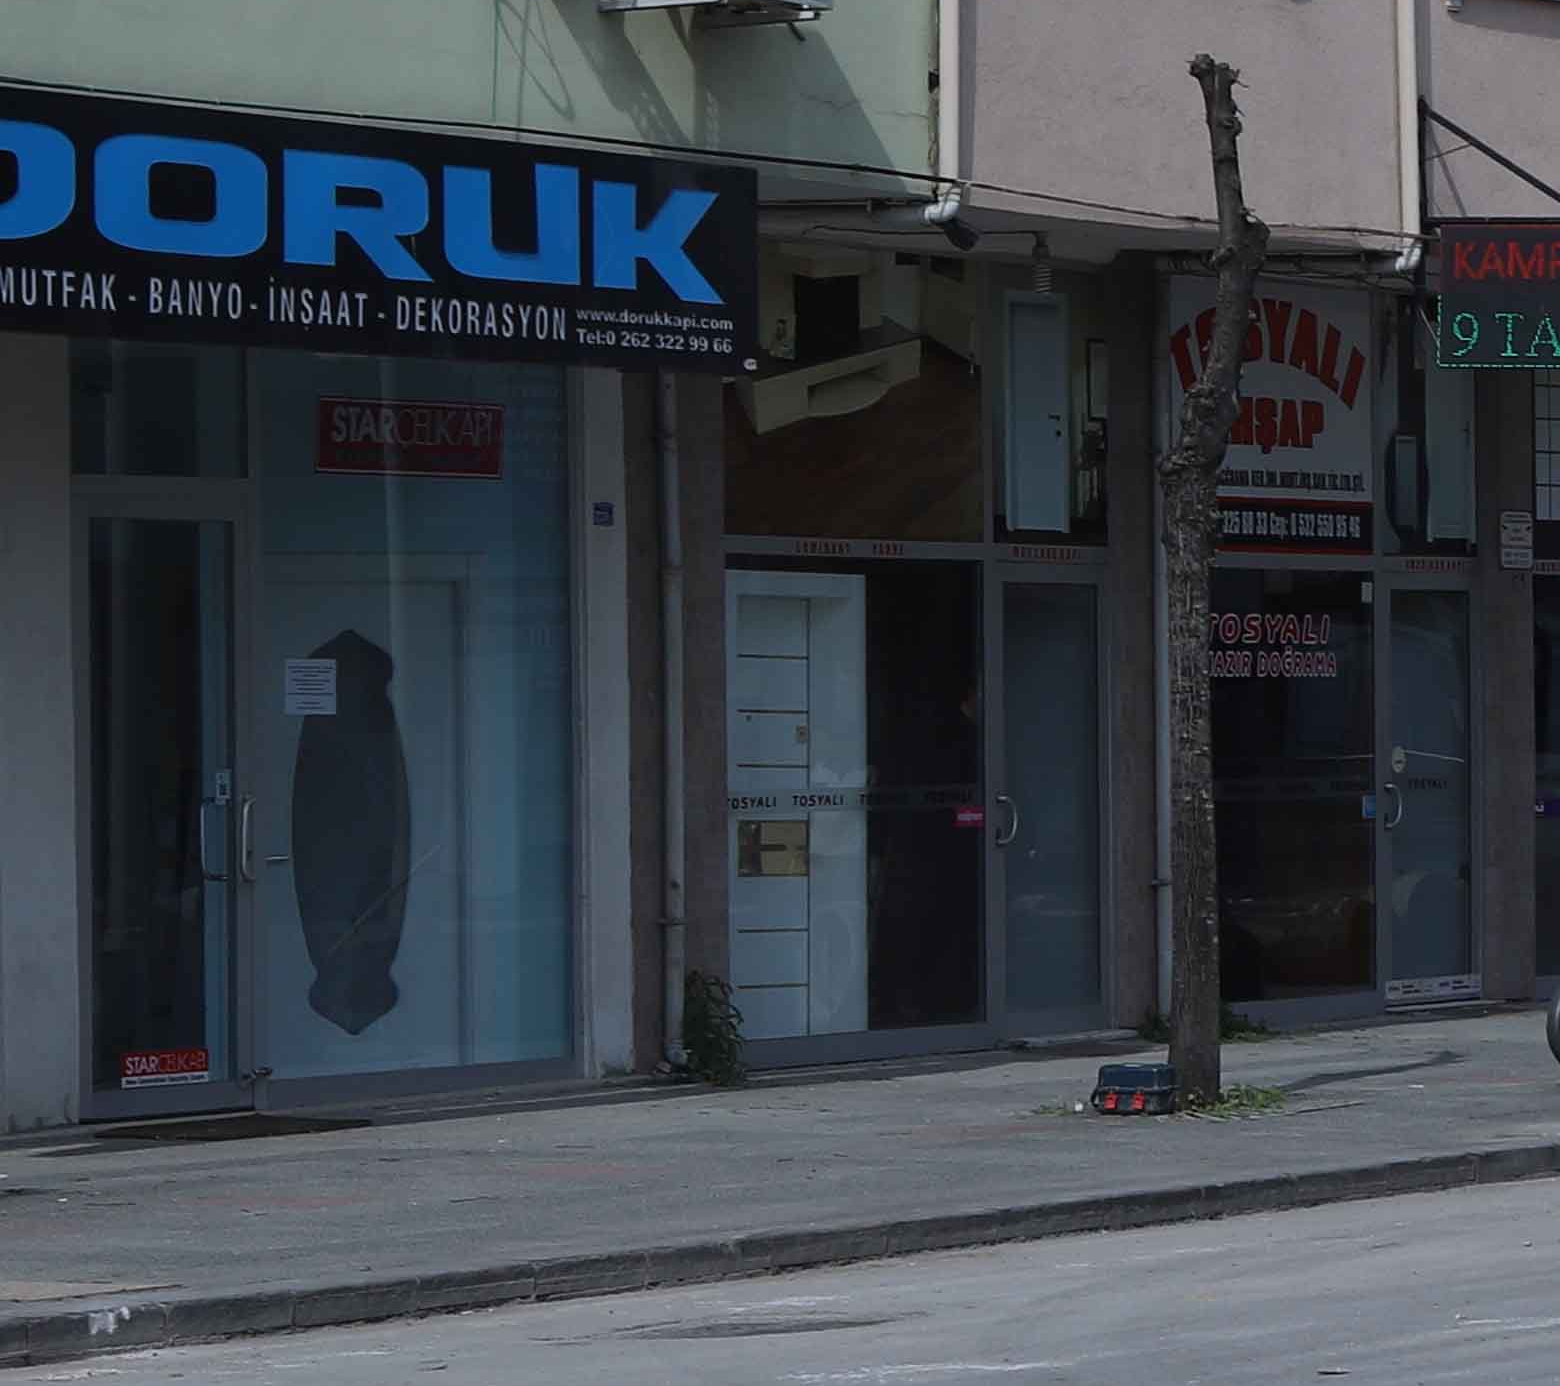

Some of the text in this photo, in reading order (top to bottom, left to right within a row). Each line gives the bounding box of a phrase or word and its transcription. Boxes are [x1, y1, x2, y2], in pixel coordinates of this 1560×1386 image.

[150, 277, 242, 319] BANYO
[269, 277, 368, 330] İNŞAAT
[396, 295, 567, 341] DEKORASYON
[576, 307, 734, 332] www.dorukkapi.com
[620, 330, 650, 349] 262
[655, 332, 684, 351] 322
[688, 334, 710, 353] 99
[713, 335, 734, 354] 66
[1451, 311, 1481, 357] 9
[1256, 644, 1337, 677] DOĞRAMA
[792, 793, 845, 807] TOSYALI
